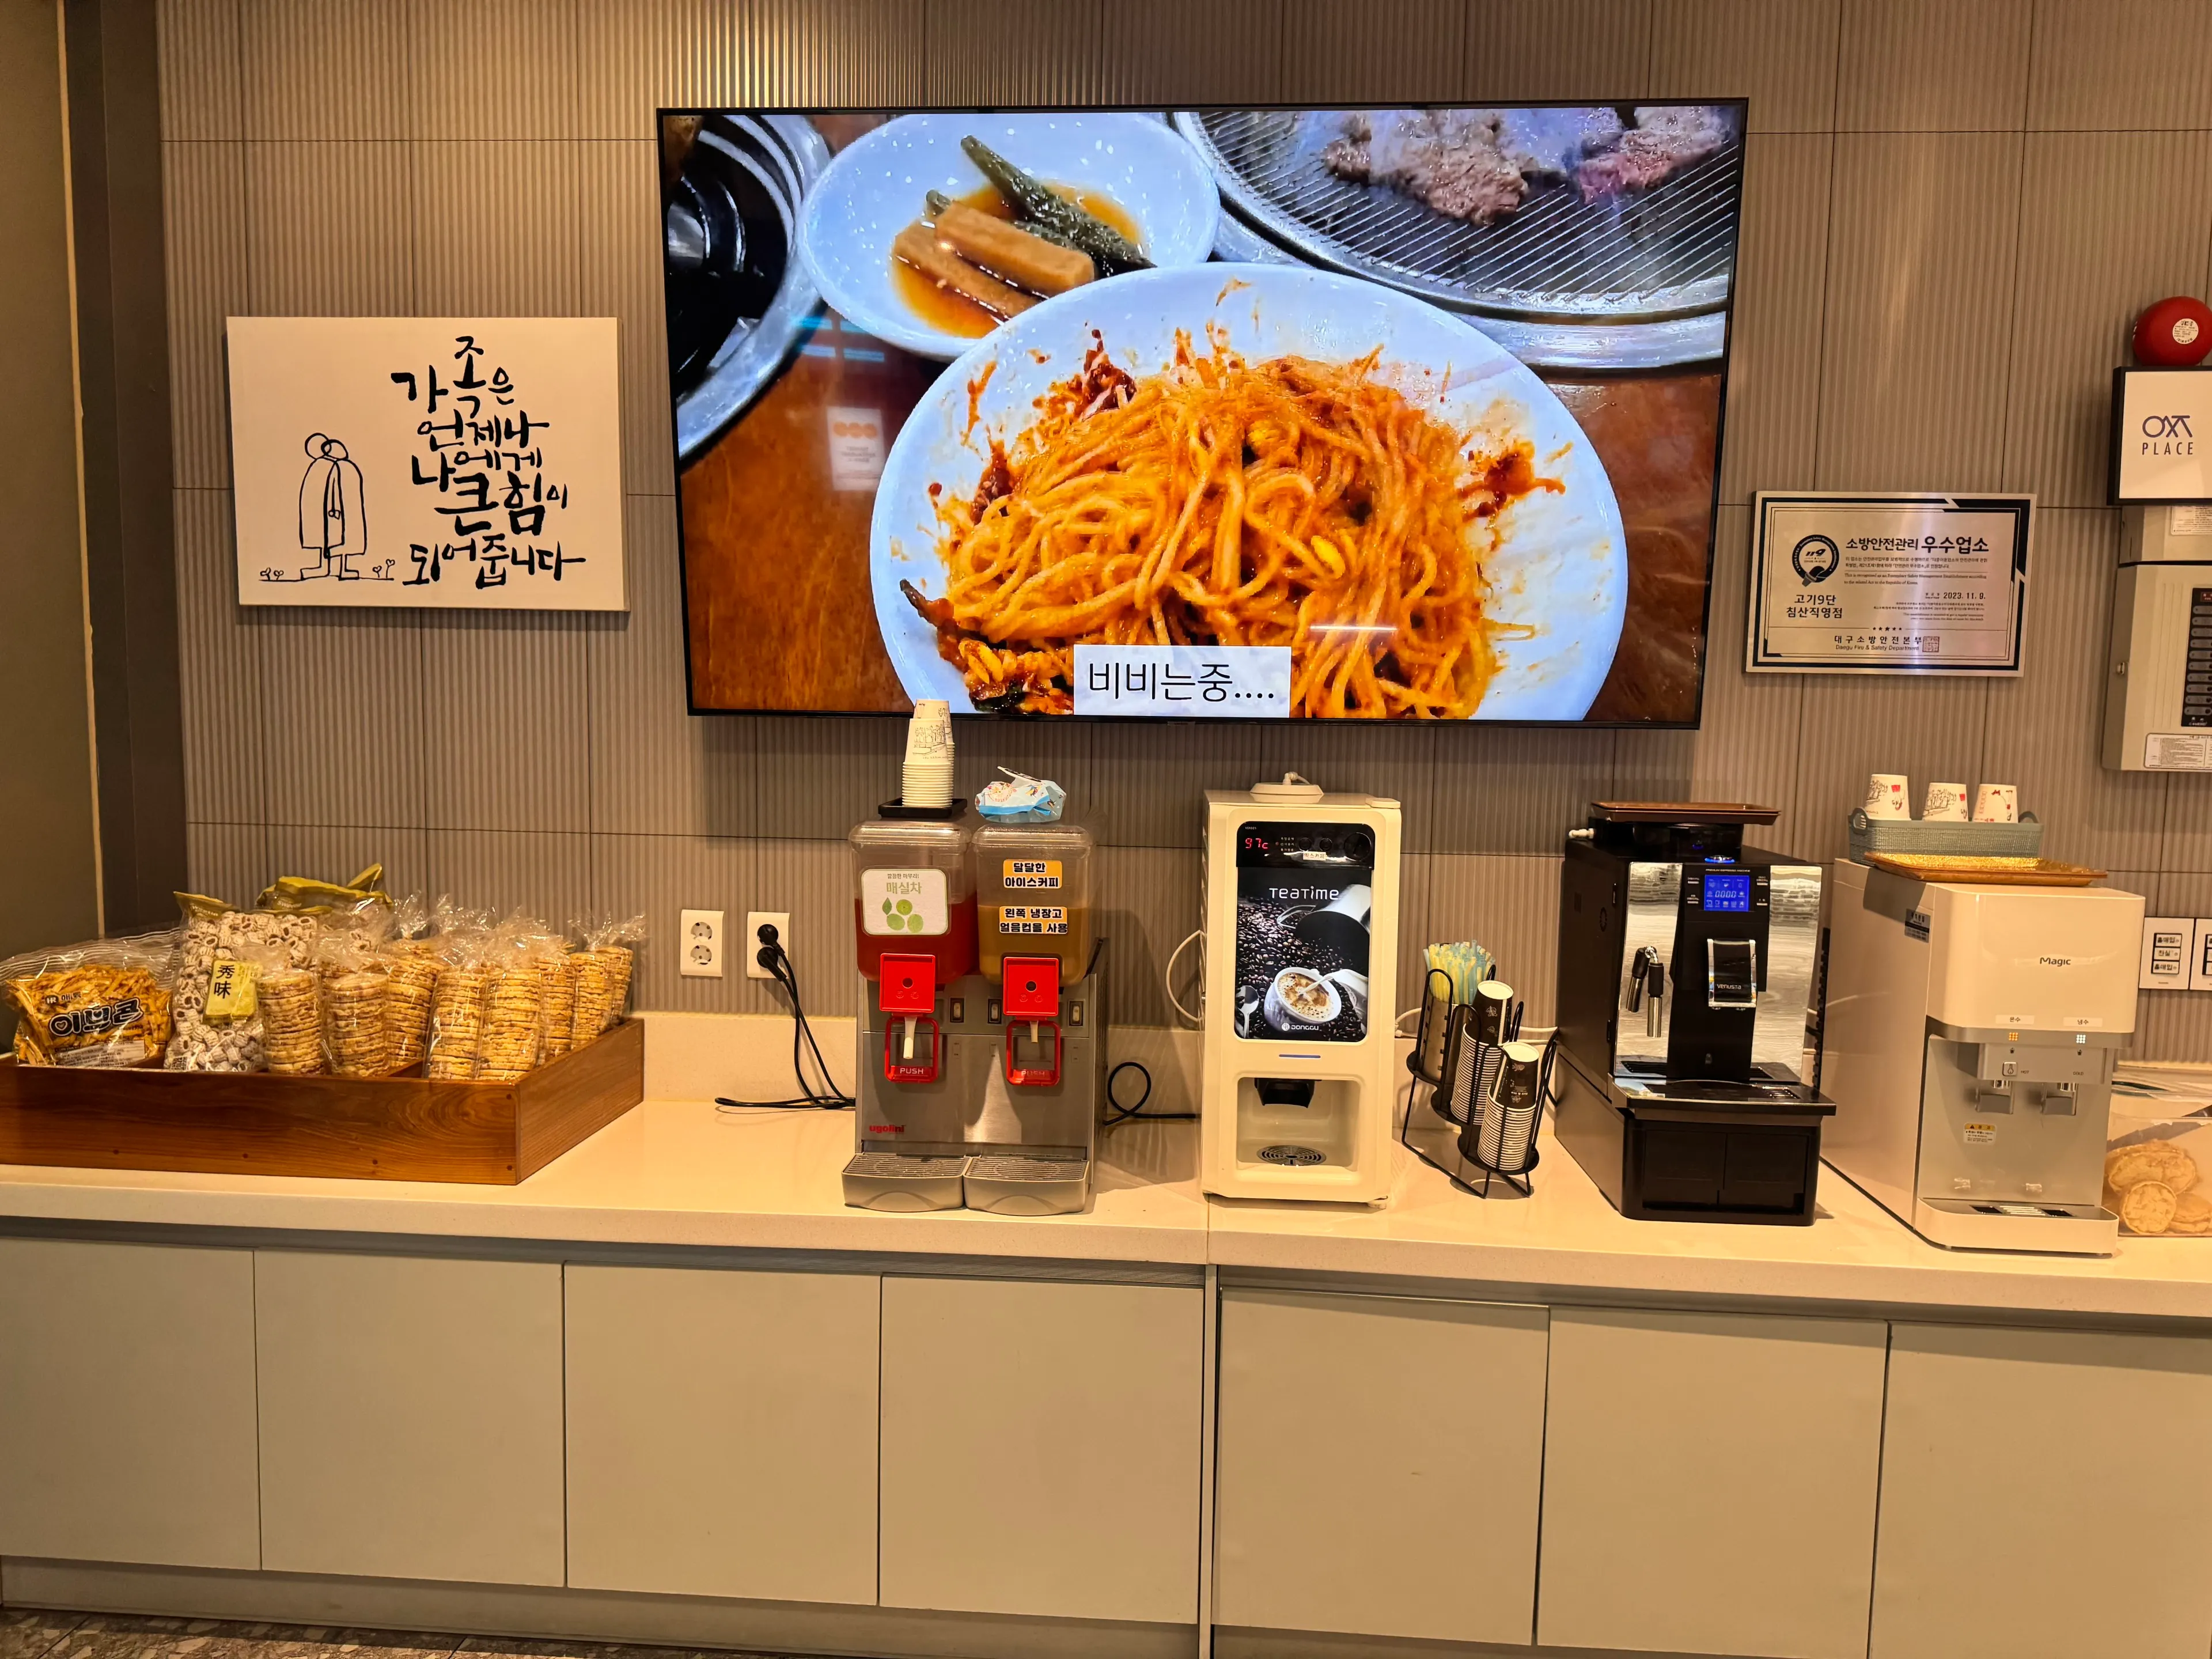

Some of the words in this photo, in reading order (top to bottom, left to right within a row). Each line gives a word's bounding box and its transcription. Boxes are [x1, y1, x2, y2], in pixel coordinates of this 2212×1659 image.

[391, 336, 514, 419] 가족은
[417, 409, 550, 451] 언제나
[2142, 442, 2194, 455] PLACE
[412, 448, 543, 493] 나에게
[434, 472, 499, 536] 큰
[499, 471, 568, 536] 힘이
[1845, 537, 1919, 551] 소방안전관리
[1921, 536, 1989, 554] 우수업소
[403, 533, 586, 589] 되어줍니다
[1794, 594, 1836, 605] 고기9단
[1786, 607, 1843, 618] 침산직영점
[1013, 862, 1046, 873] 달달한
[886, 881, 922, 895] 매실차
[1005, 877, 1059, 887] 아이스커피
[1005, 908, 1026, 918] 왼쪽
[1031, 908, 1062, 919] 냉장고
[1000, 922, 1043, 933] 얼음컵을
[1047, 923, 1068, 933] 사용
[2039, 957, 2071, 967] Magic
[214, 964, 235, 999] 秀味
[899, 1067, 924, 1075] PUSH
[869, 1124, 905, 1134] ugolini
